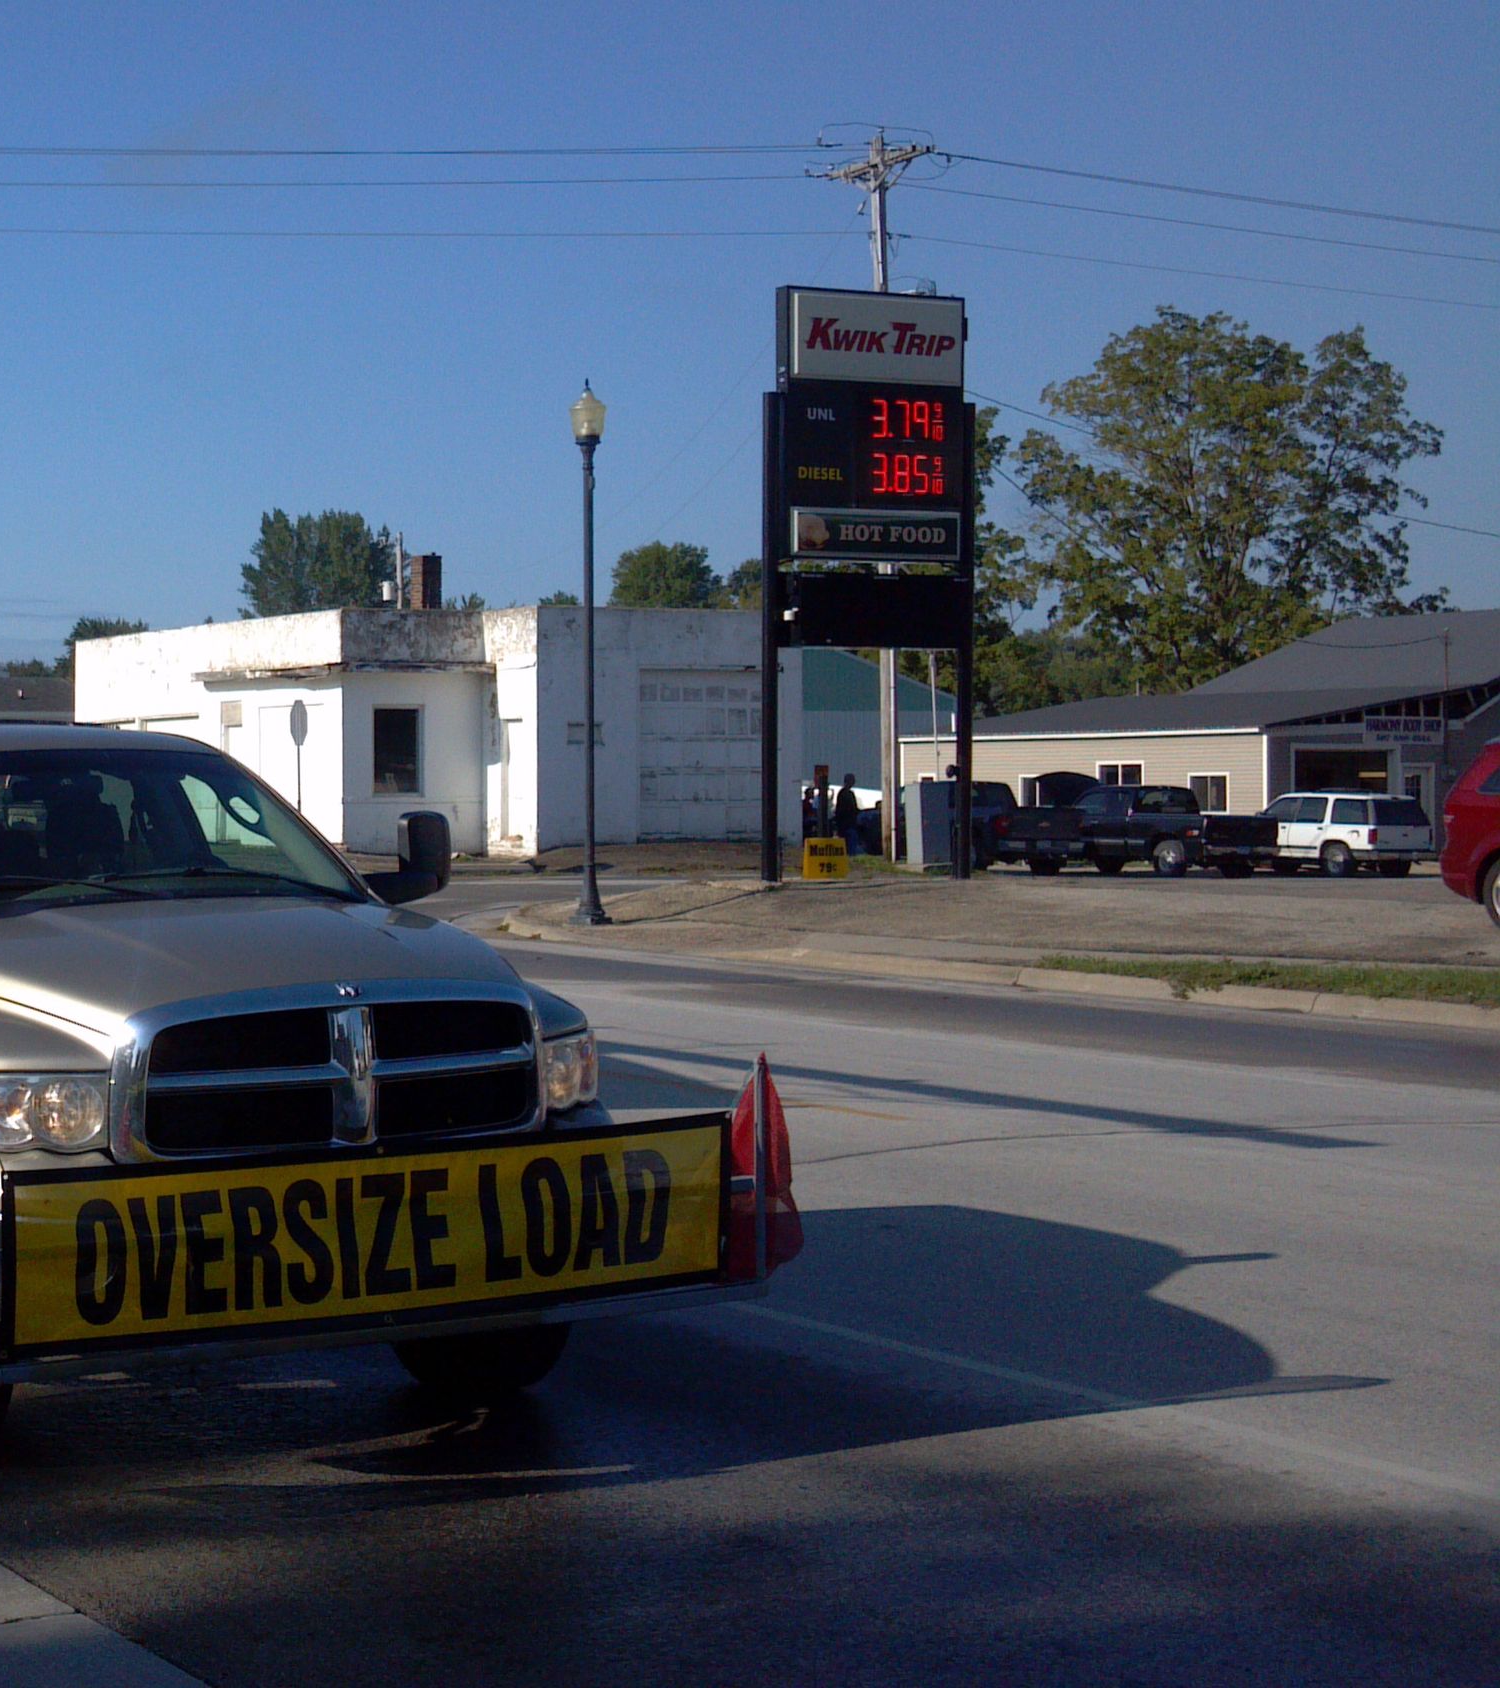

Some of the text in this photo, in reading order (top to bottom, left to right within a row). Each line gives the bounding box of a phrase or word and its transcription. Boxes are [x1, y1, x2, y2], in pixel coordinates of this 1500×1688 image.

[807, 407, 836, 421] UNL
[872, 399, 929, 438] 3.79
[798, 466, 843, 480] DIESEL
[872, 453, 929, 493] 3.85
[839, 524, 946, 543] HOT FOOD
[75, 1149, 671, 1326] OVERSIZE LOAD
